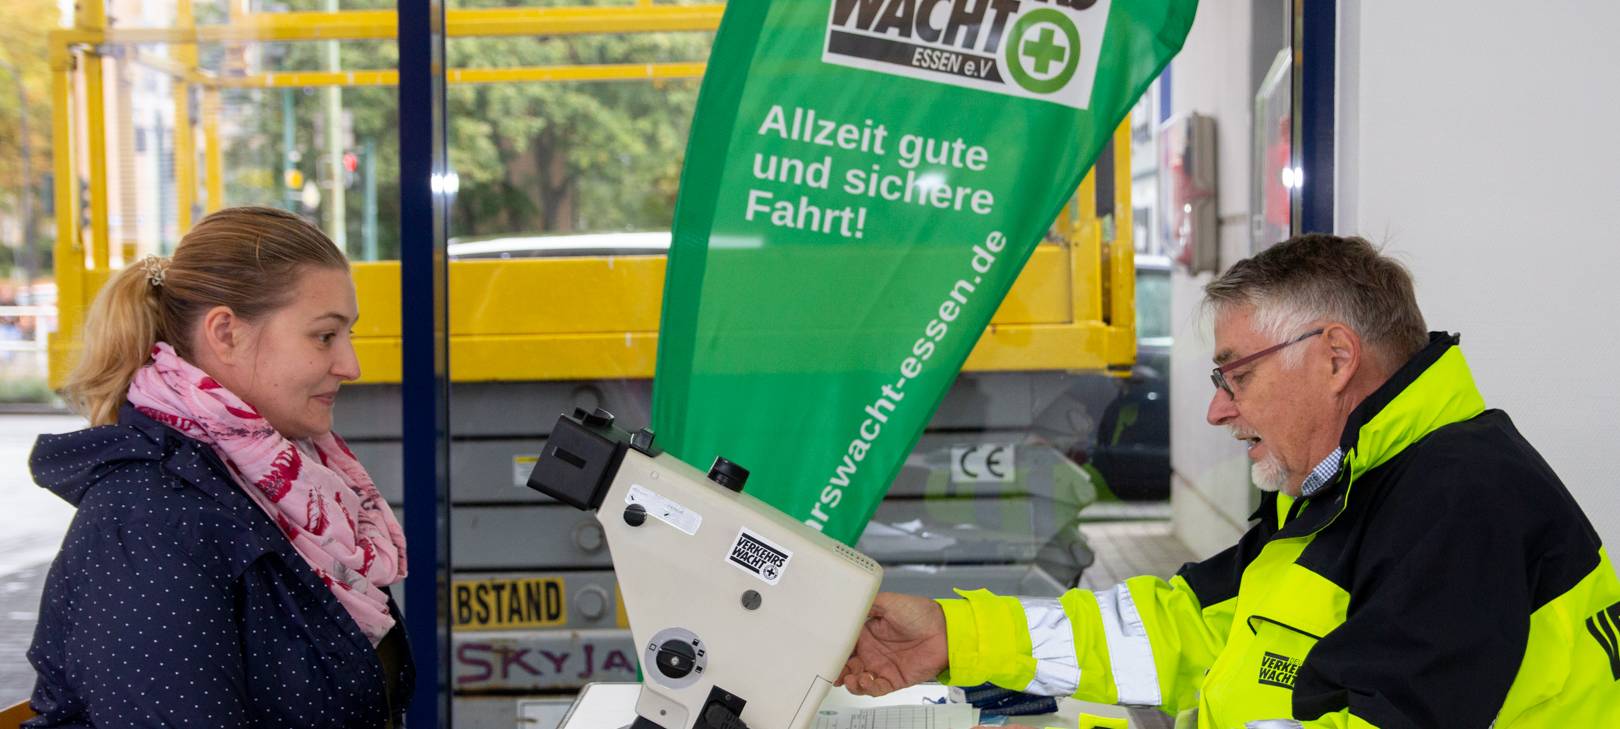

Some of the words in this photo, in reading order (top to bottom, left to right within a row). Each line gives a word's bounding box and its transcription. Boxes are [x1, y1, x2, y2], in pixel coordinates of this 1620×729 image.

[831, 0, 1018, 54] WACHT
[912, 48, 962, 72] ESSEN
[964, 60, 992, 78] e.V
[758, 105, 888, 154] Allzeit
[898, 134, 989, 171] gute
[752, 152, 832, 189] und
[843, 165, 994, 215] sichere
[745, 190, 867, 239] Fahrt!
[960, 447, 1005, 478] CE
[732, 546, 767, 569] WACHT
[737, 537, 785, 567] VERKEHRS
[451, 581, 562, 625] BSTAND
